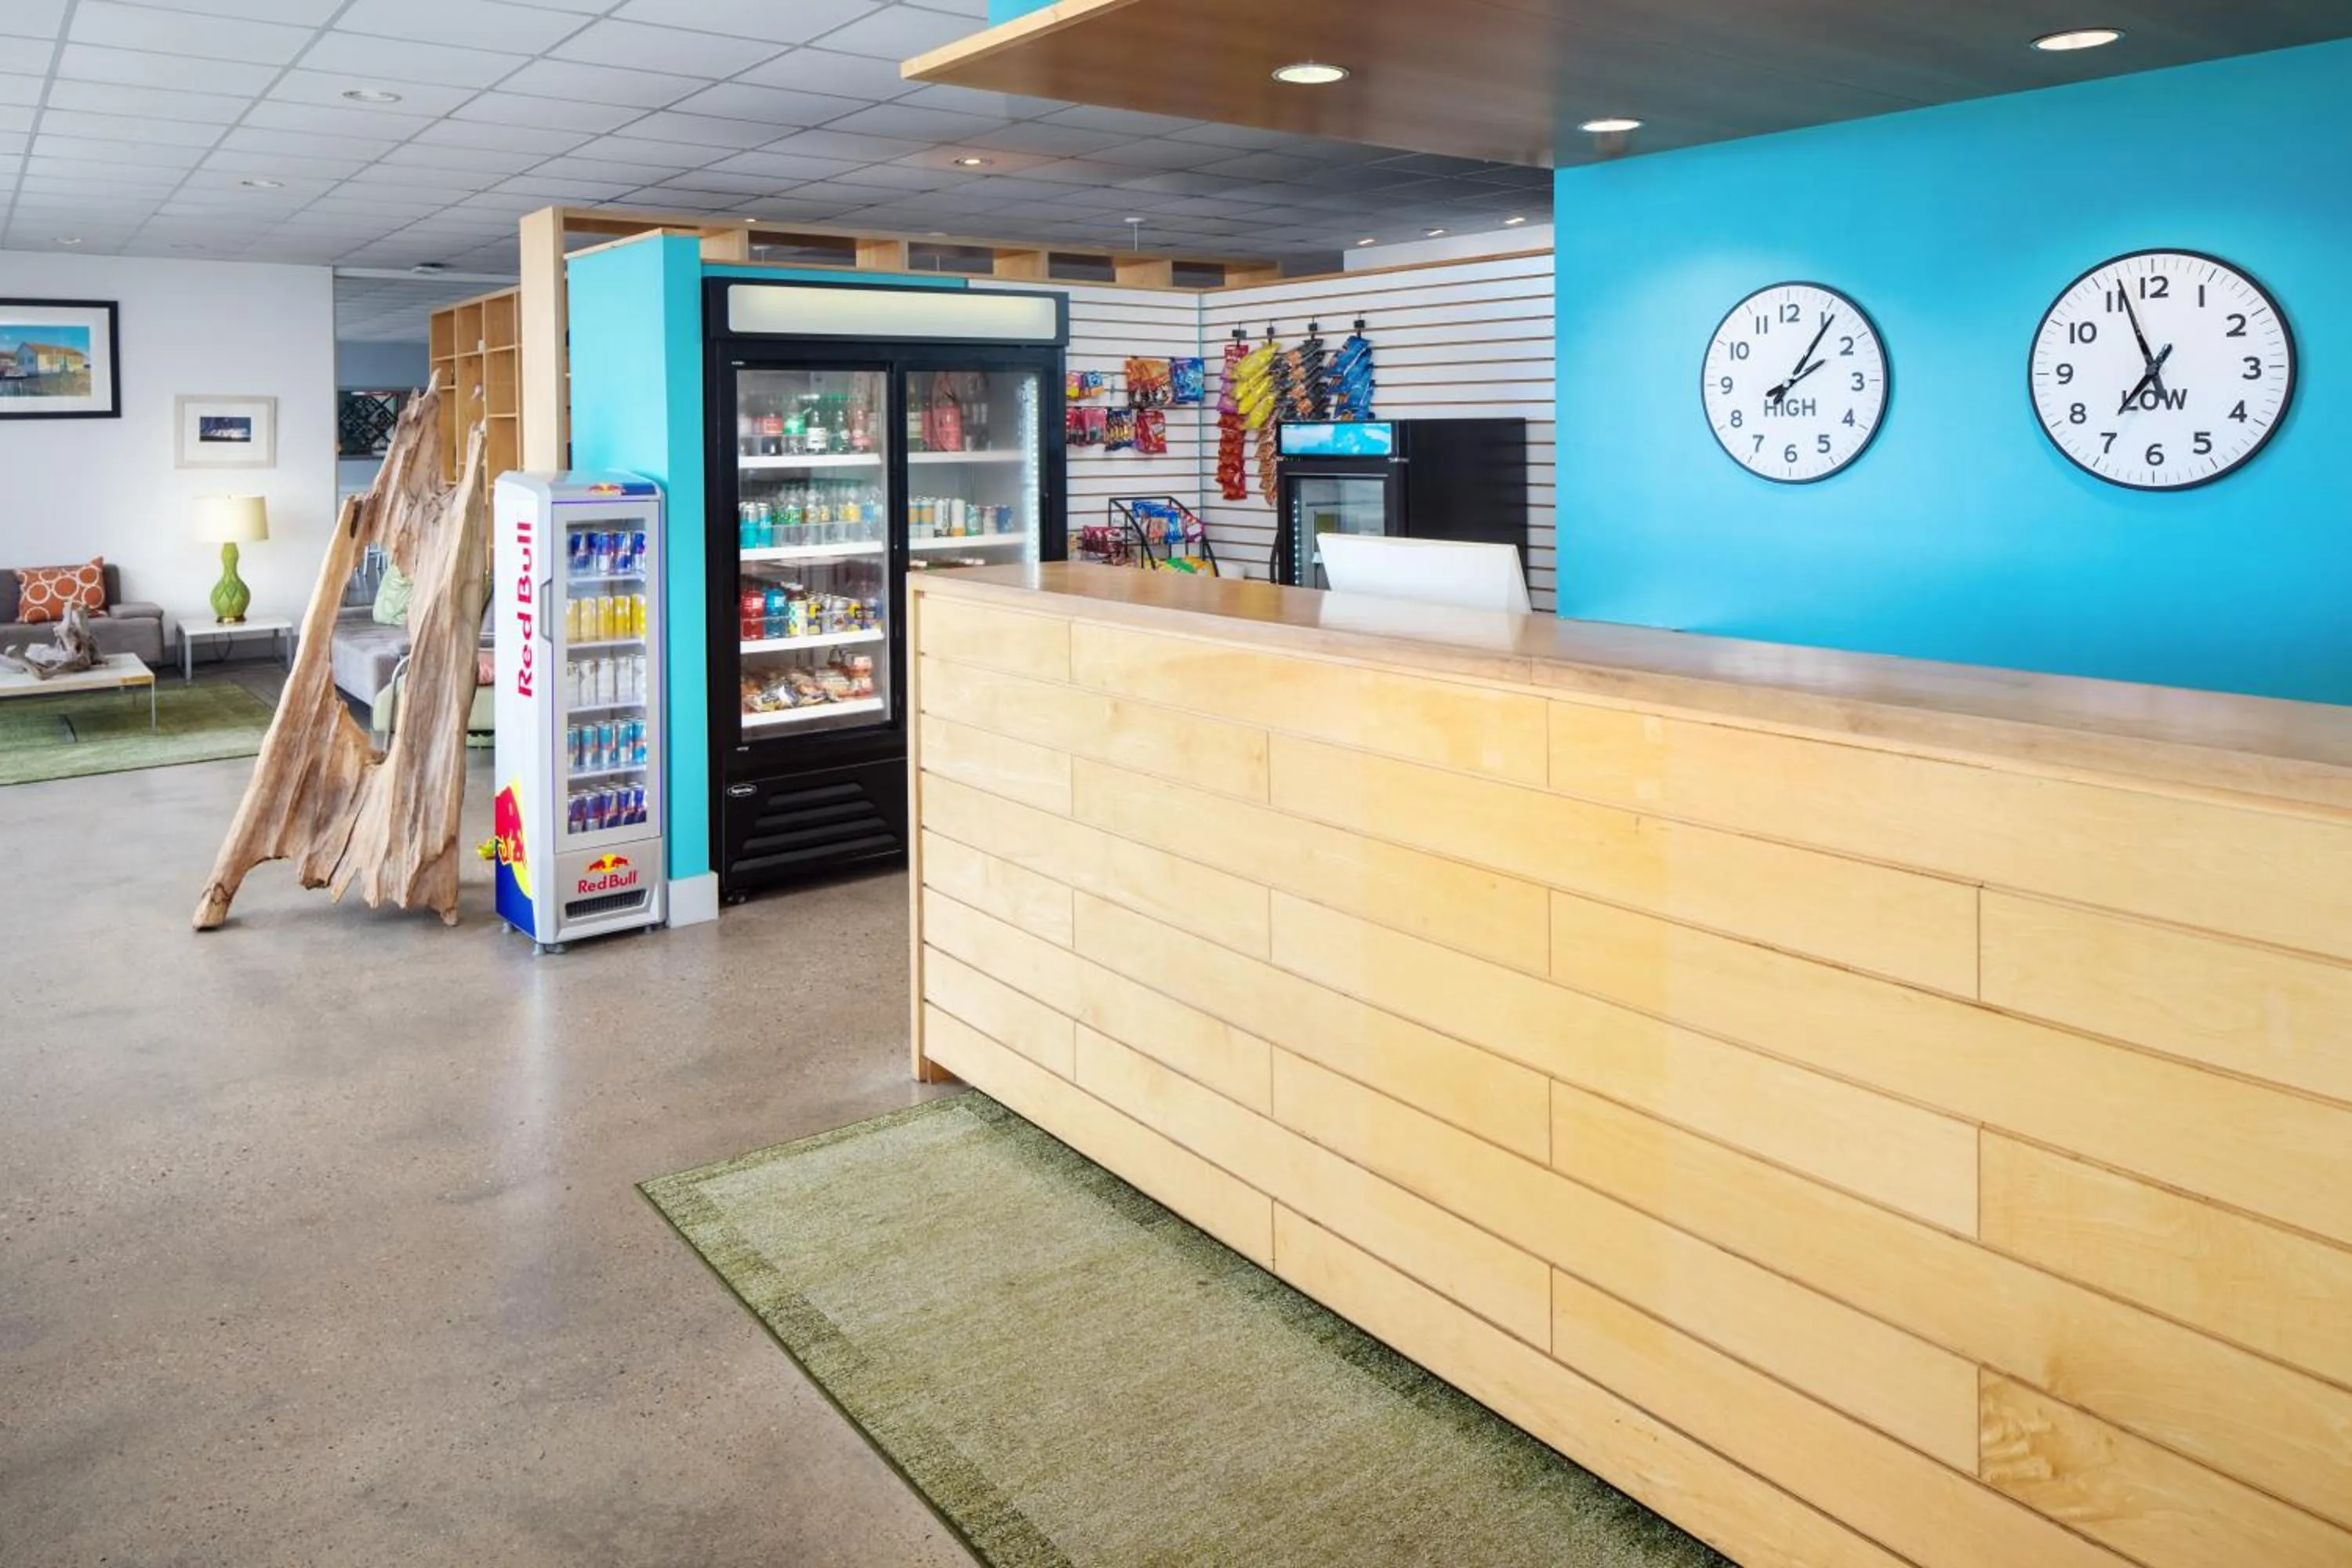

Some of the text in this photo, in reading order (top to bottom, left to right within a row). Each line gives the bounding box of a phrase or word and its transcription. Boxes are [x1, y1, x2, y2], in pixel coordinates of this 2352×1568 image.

[2140, 276, 2169, 299] 12
[2198, 284, 2205, 308] 1
[2106, 290, 2125, 313] 11
[1780, 304, 1799, 323] 12
[1756, 315, 1767, 334] 11
[2070, 321, 2096, 343] 10
[2227, 314, 2245, 337] 2
[1730, 342, 1749, 360] 10
[1840, 336, 1853, 355] 2
[2056, 364, 2073, 384] 9
[2242, 357, 2261, 379] 3
[1721, 376, 1733, 394] 9
[1852, 372, 1864, 391] 3
[1763, 397, 1816, 416] HIGH
[2122, 388, 2187, 410] LOW
[1731, 410, 1742, 428] 8
[1842, 408, 1855, 426] 4
[2070, 403, 2086, 424] 8
[2228, 401, 2247, 423] 4
[1753, 434, 1764, 452] 7
[1817, 434, 1831, 453] 5
[2100, 433, 2117, 453] 7
[2194, 432, 2212, 455] 5
[1784, 445, 1797, 463] 6
[2146, 444, 2164, 466] 6
[517, 522, 532, 697] Red Bull
[578, 869, 637, 894] Red Bull
